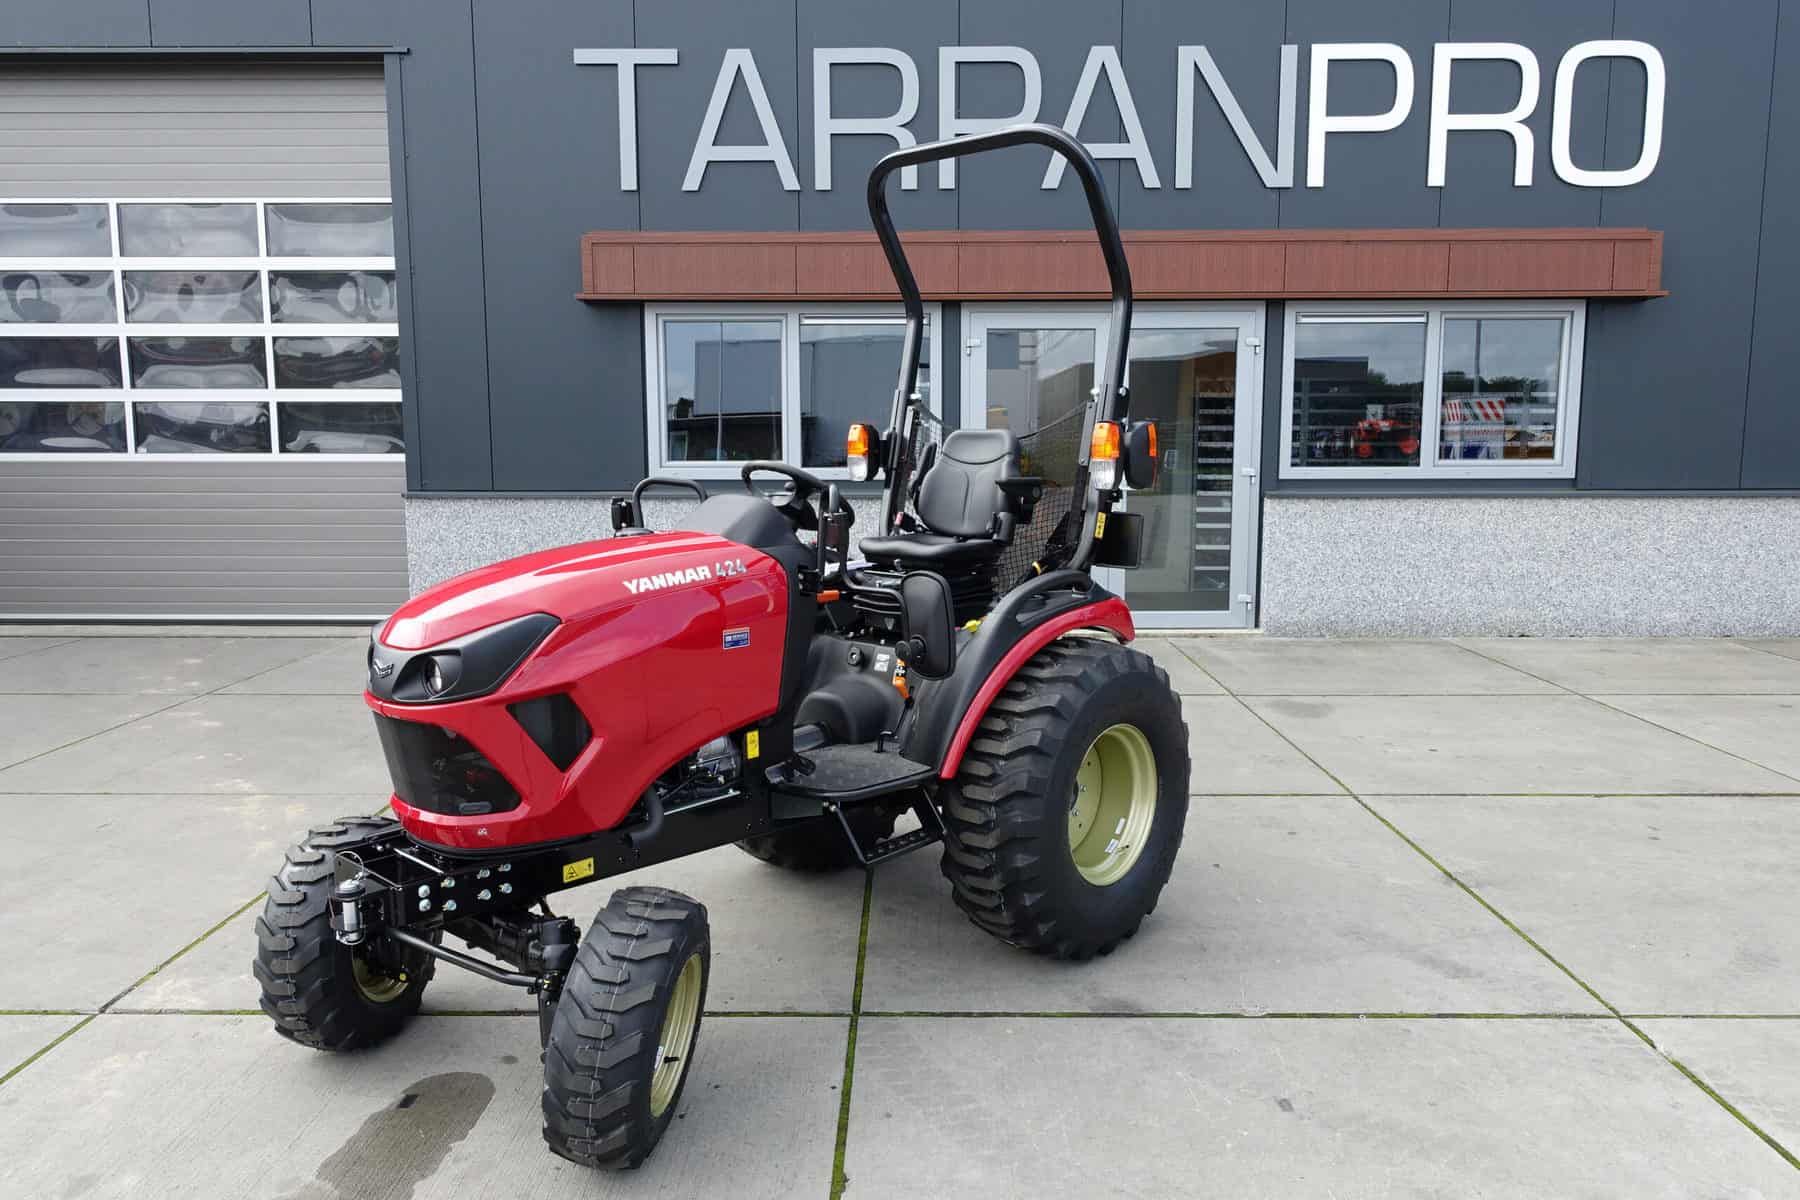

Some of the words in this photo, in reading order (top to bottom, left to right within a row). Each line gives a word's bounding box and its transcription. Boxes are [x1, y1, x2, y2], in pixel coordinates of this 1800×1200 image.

[573, 39, 1666, 192] TARPANPRO
[622, 565, 712, 594] YANMAR
[715, 558, 748, 578] 424
